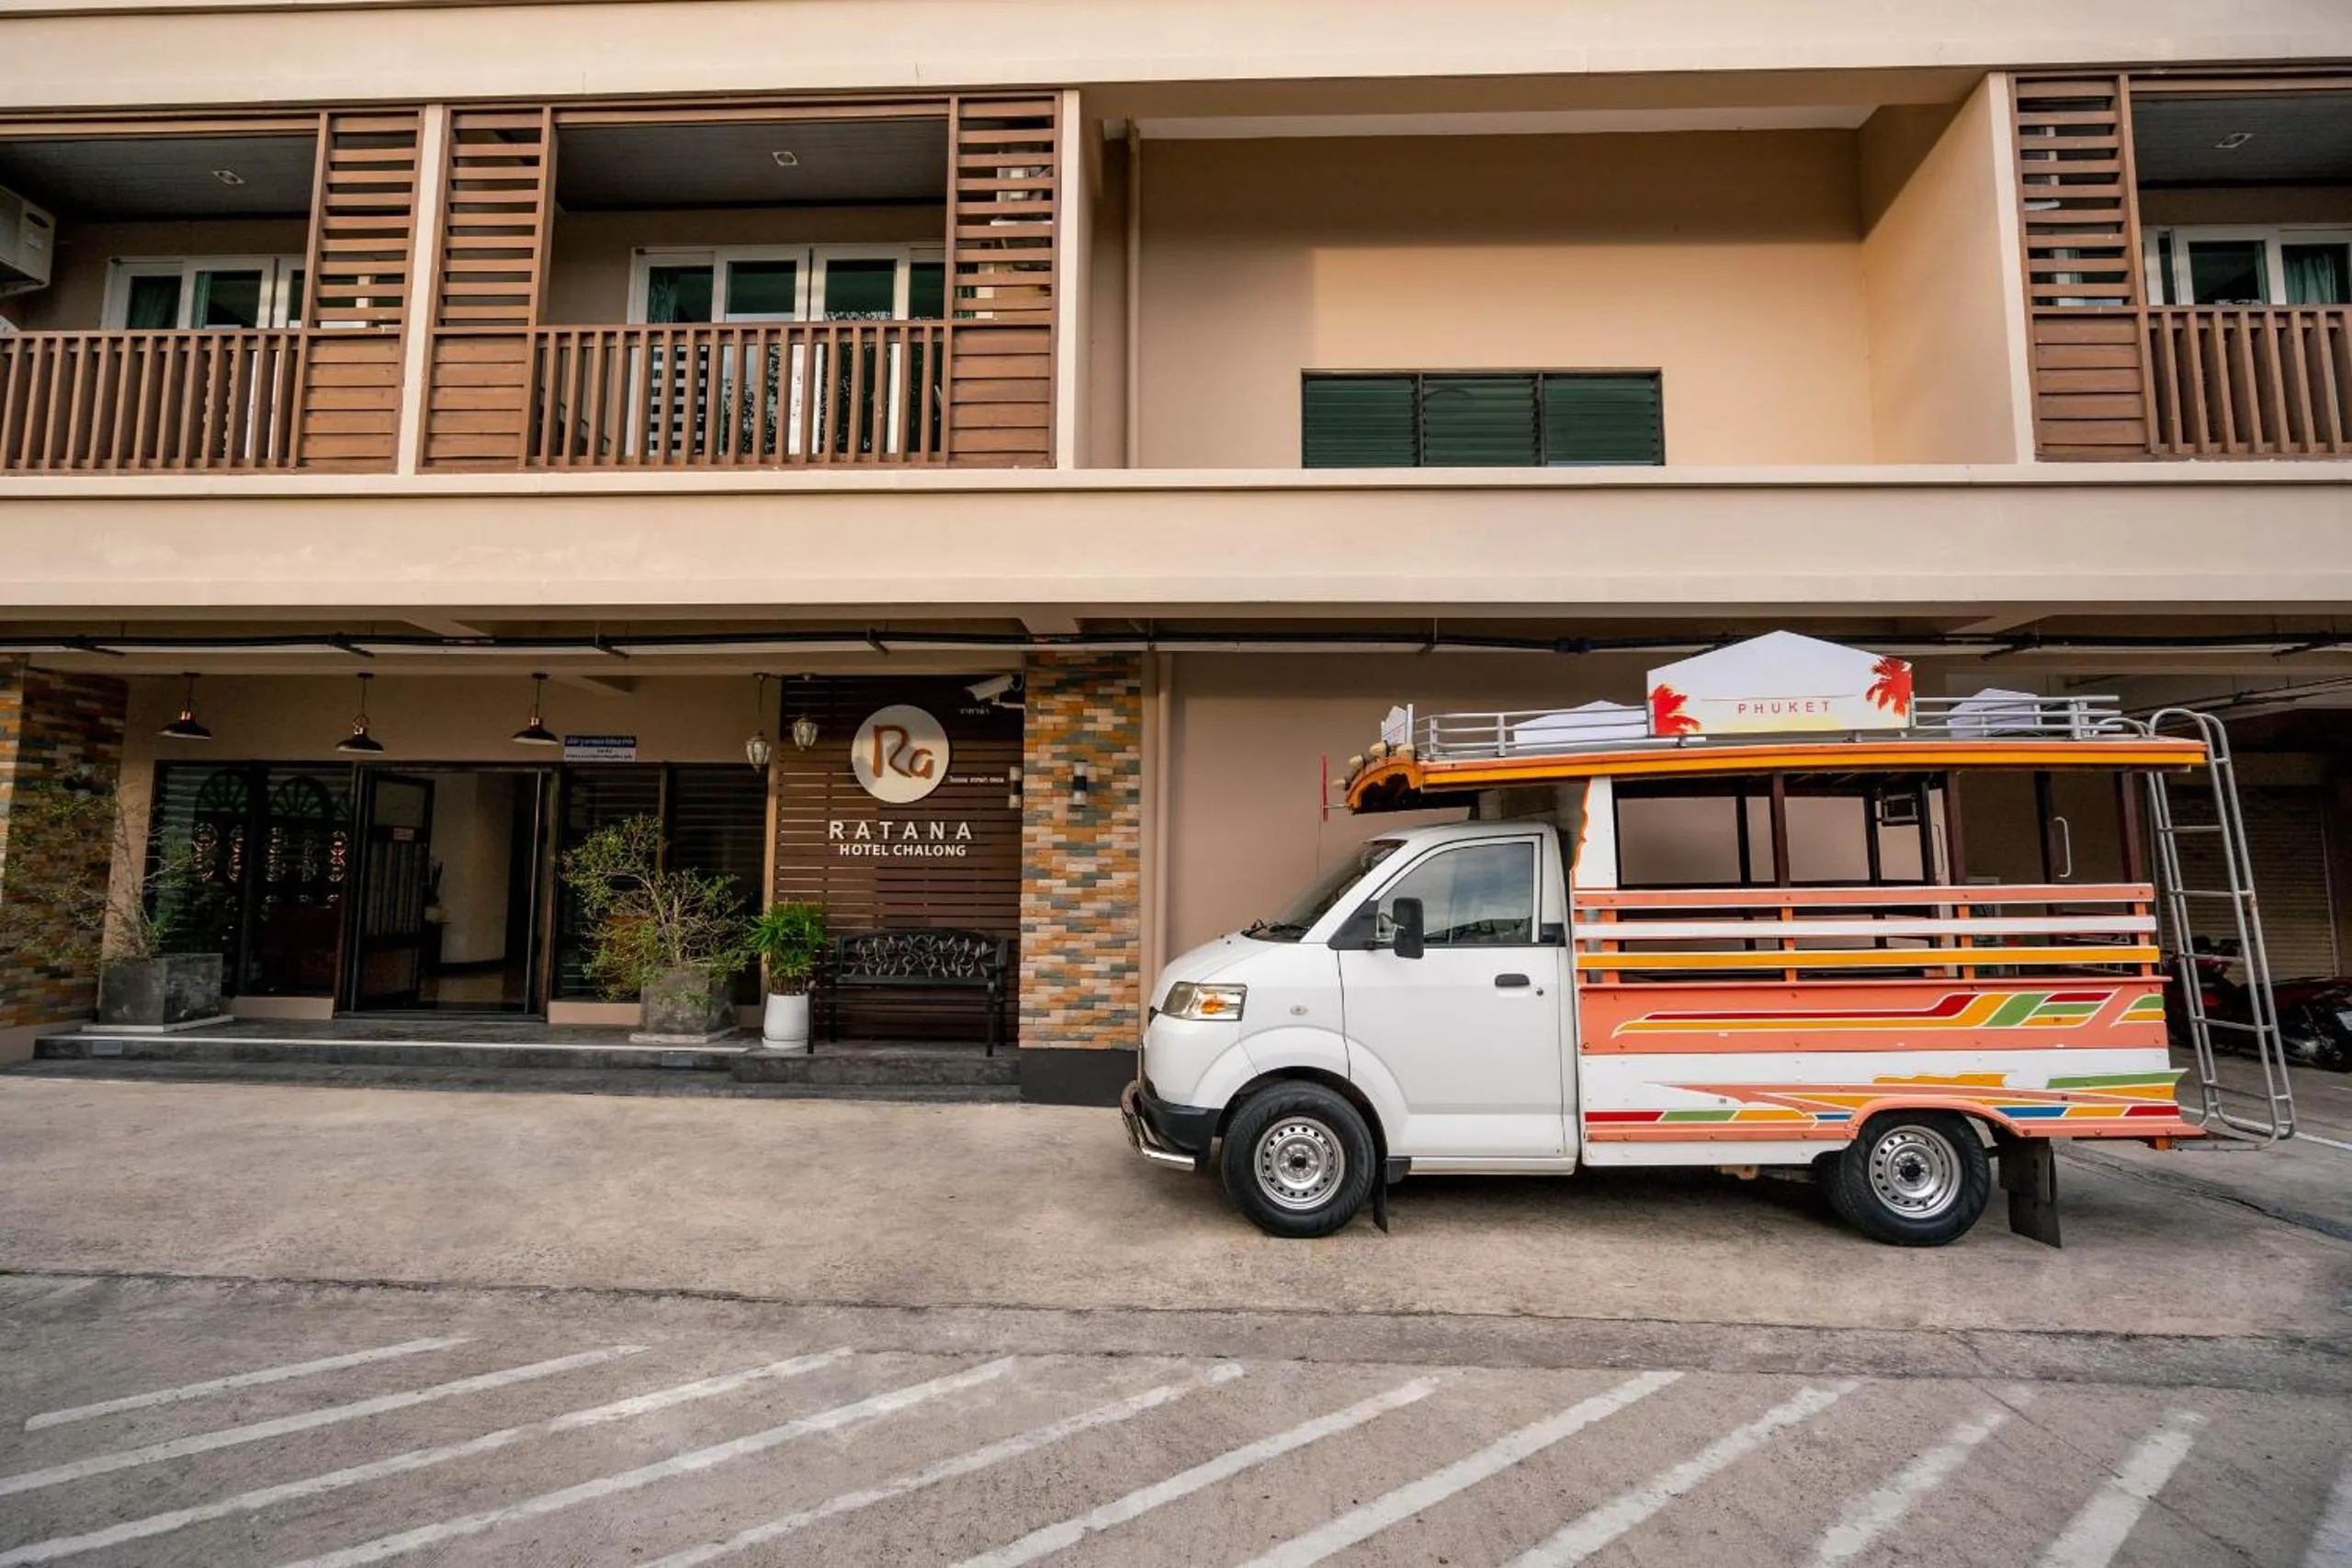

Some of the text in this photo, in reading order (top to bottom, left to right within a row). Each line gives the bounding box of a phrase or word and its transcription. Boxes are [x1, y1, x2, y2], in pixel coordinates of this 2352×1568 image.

[1737, 701, 1830, 714] PHUKET
[829, 821, 972, 840] RATANA
[840, 844, 966, 856] HOTEL CHALONG
